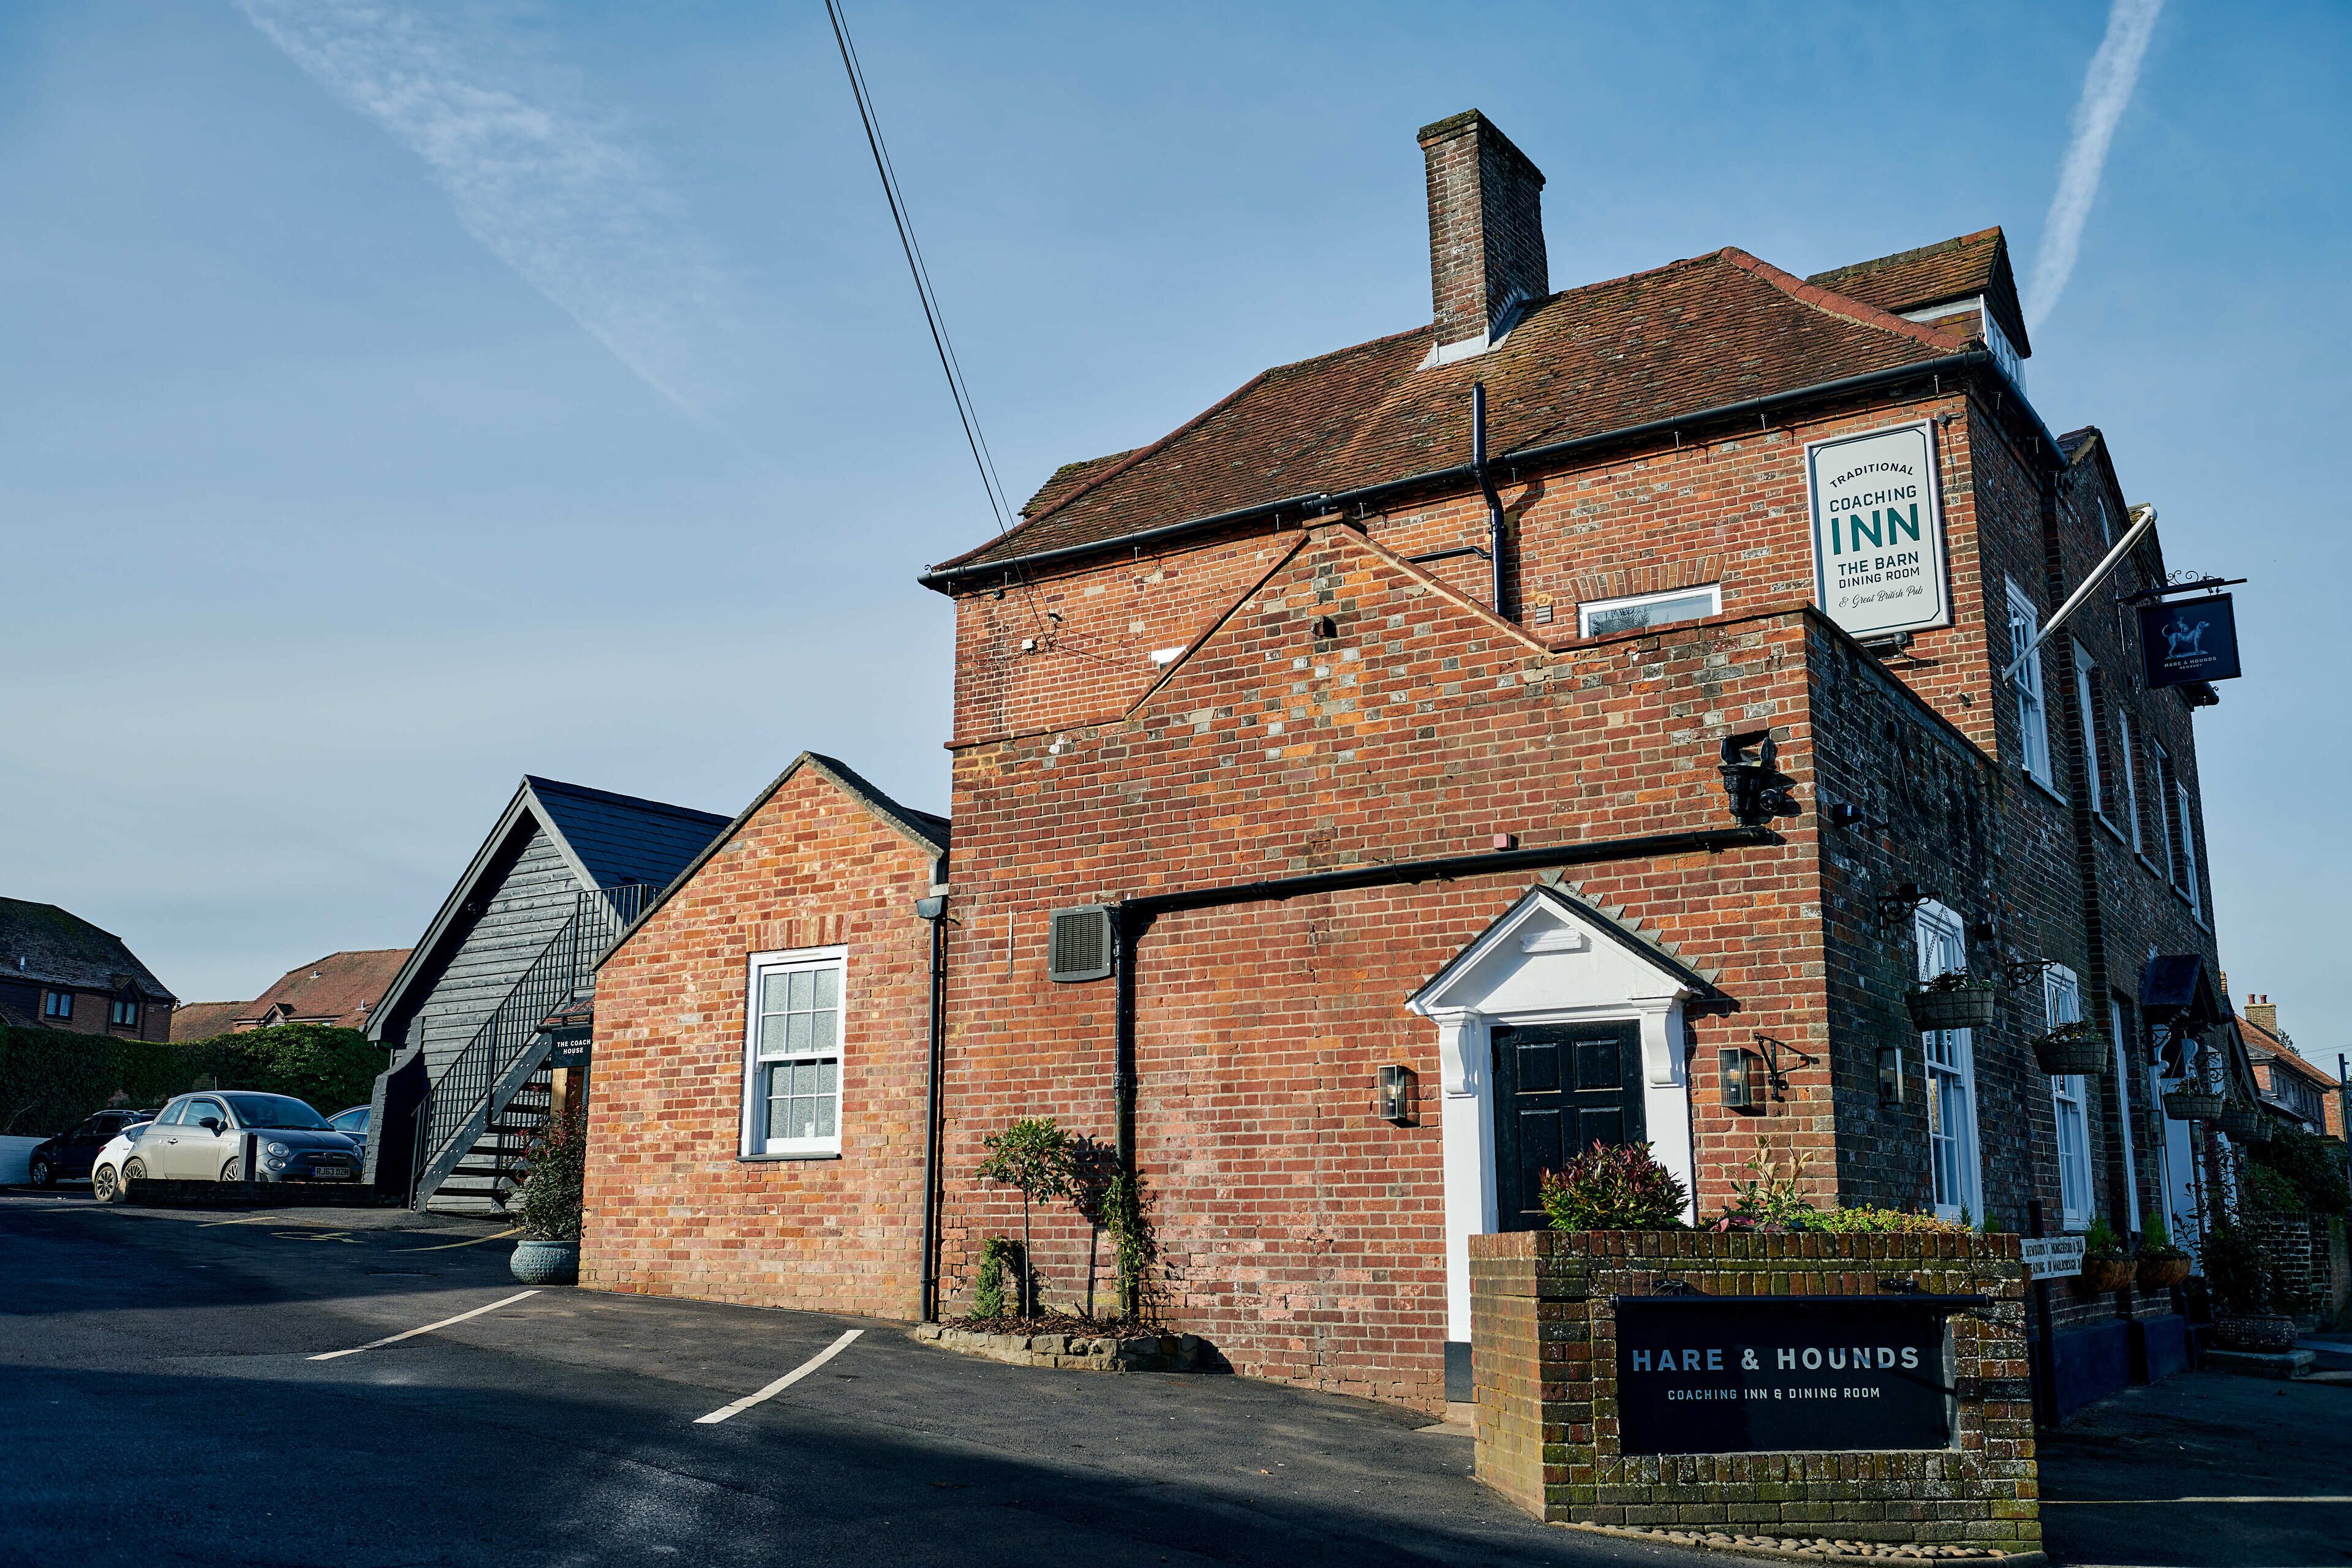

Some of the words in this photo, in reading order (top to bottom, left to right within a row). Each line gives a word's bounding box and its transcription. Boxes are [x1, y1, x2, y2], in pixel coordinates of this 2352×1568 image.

[1830, 462, 1913, 488] TRADITIONAL
[1830, 484, 1917, 512] COACHING
[1831, 503, 1920, 556] INN
[1838, 560, 1869, 576] THE
[1875, 551, 1919, 570] BARN
[1839, 573, 1882, 589] DINING
[1886, 567, 1920, 581] ROOM
[1839, 596, 1849, 608] &
[1852, 594, 1875, 608] Great
[1877, 589, 1904, 601] British
[1906, 585, 1923, 597] Pub
[2030, 1261, 2045, 1275] EADING
[1632, 1348, 1724, 1372] HARE
[1741, 1348, 1760, 1371] &
[1777, 1346, 1920, 1371] HOUNDS
[1667, 1389, 1737, 1401] COACHING
[1744, 1388, 1768, 1400] INN
[1774, 1388, 1782, 1400] &
[1789, 1387, 1838, 1400] DINING
[1843, 1387, 1880, 1399] ROOM
